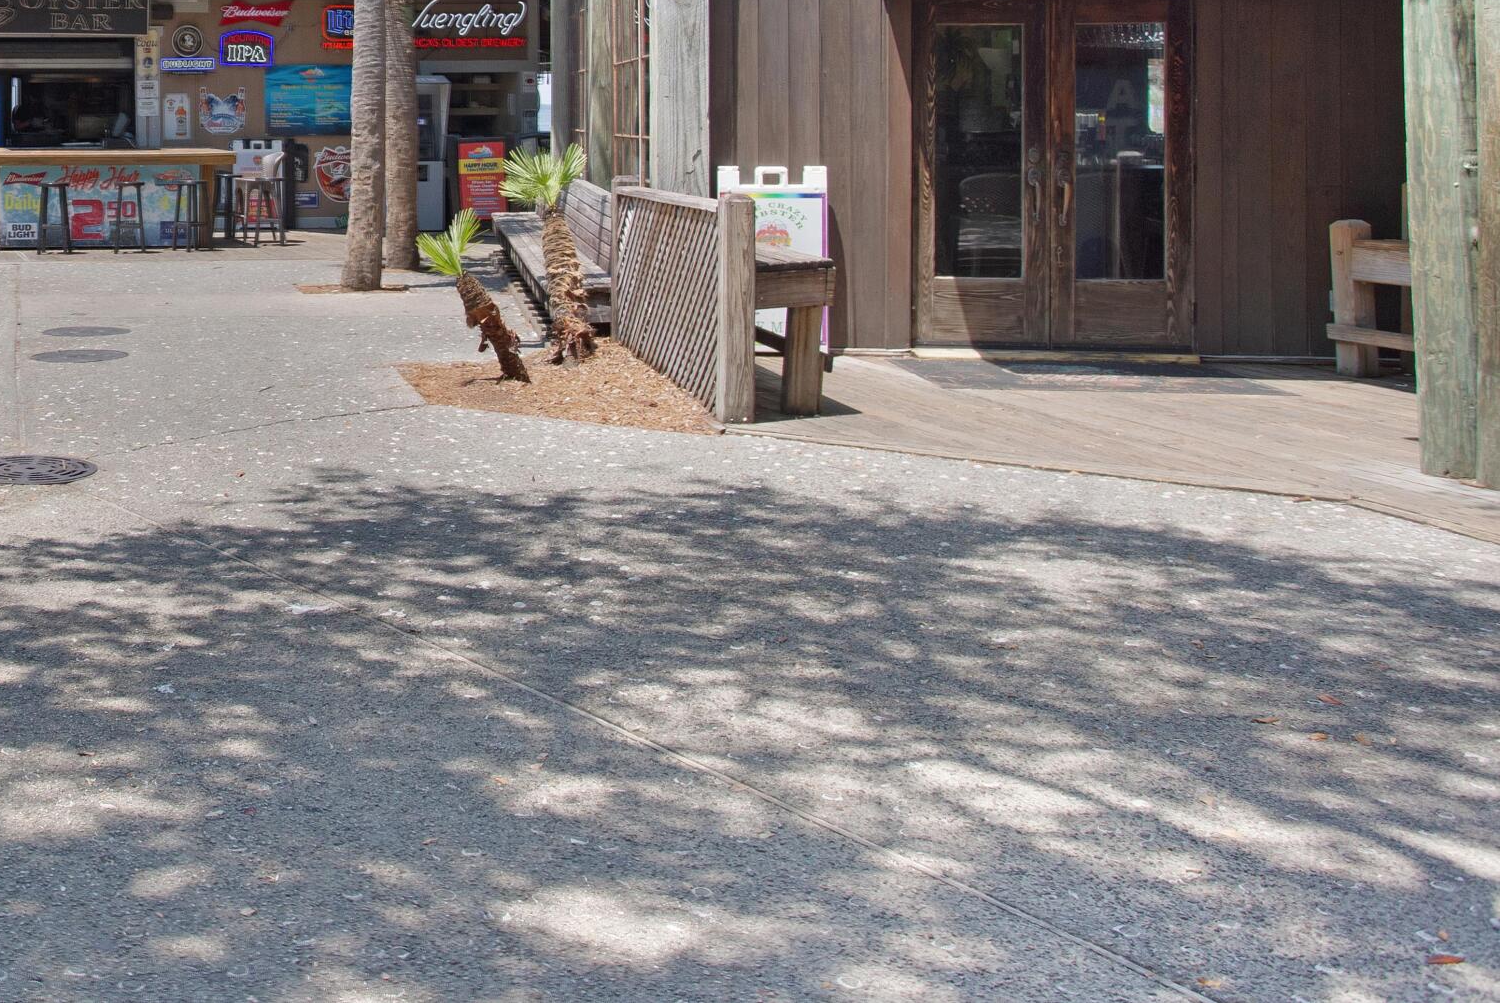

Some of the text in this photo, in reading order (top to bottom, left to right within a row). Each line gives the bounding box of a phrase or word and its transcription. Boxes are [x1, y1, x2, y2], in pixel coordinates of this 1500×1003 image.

[221, 5, 289, 18] Budweiser
[49, 12, 114, 31] BAR
[327, 9, 355, 35] Lit
[227, 44, 267, 63] IPA
[54, 165, 140, 190] Happy Hour
[4, 192, 41, 214] Daily
[768, 202, 808, 221] CRAZY
[11, 224, 32, 232] BUD
[70, 199, 105, 240] 2
[8, 231, 36, 239] LIGHT
